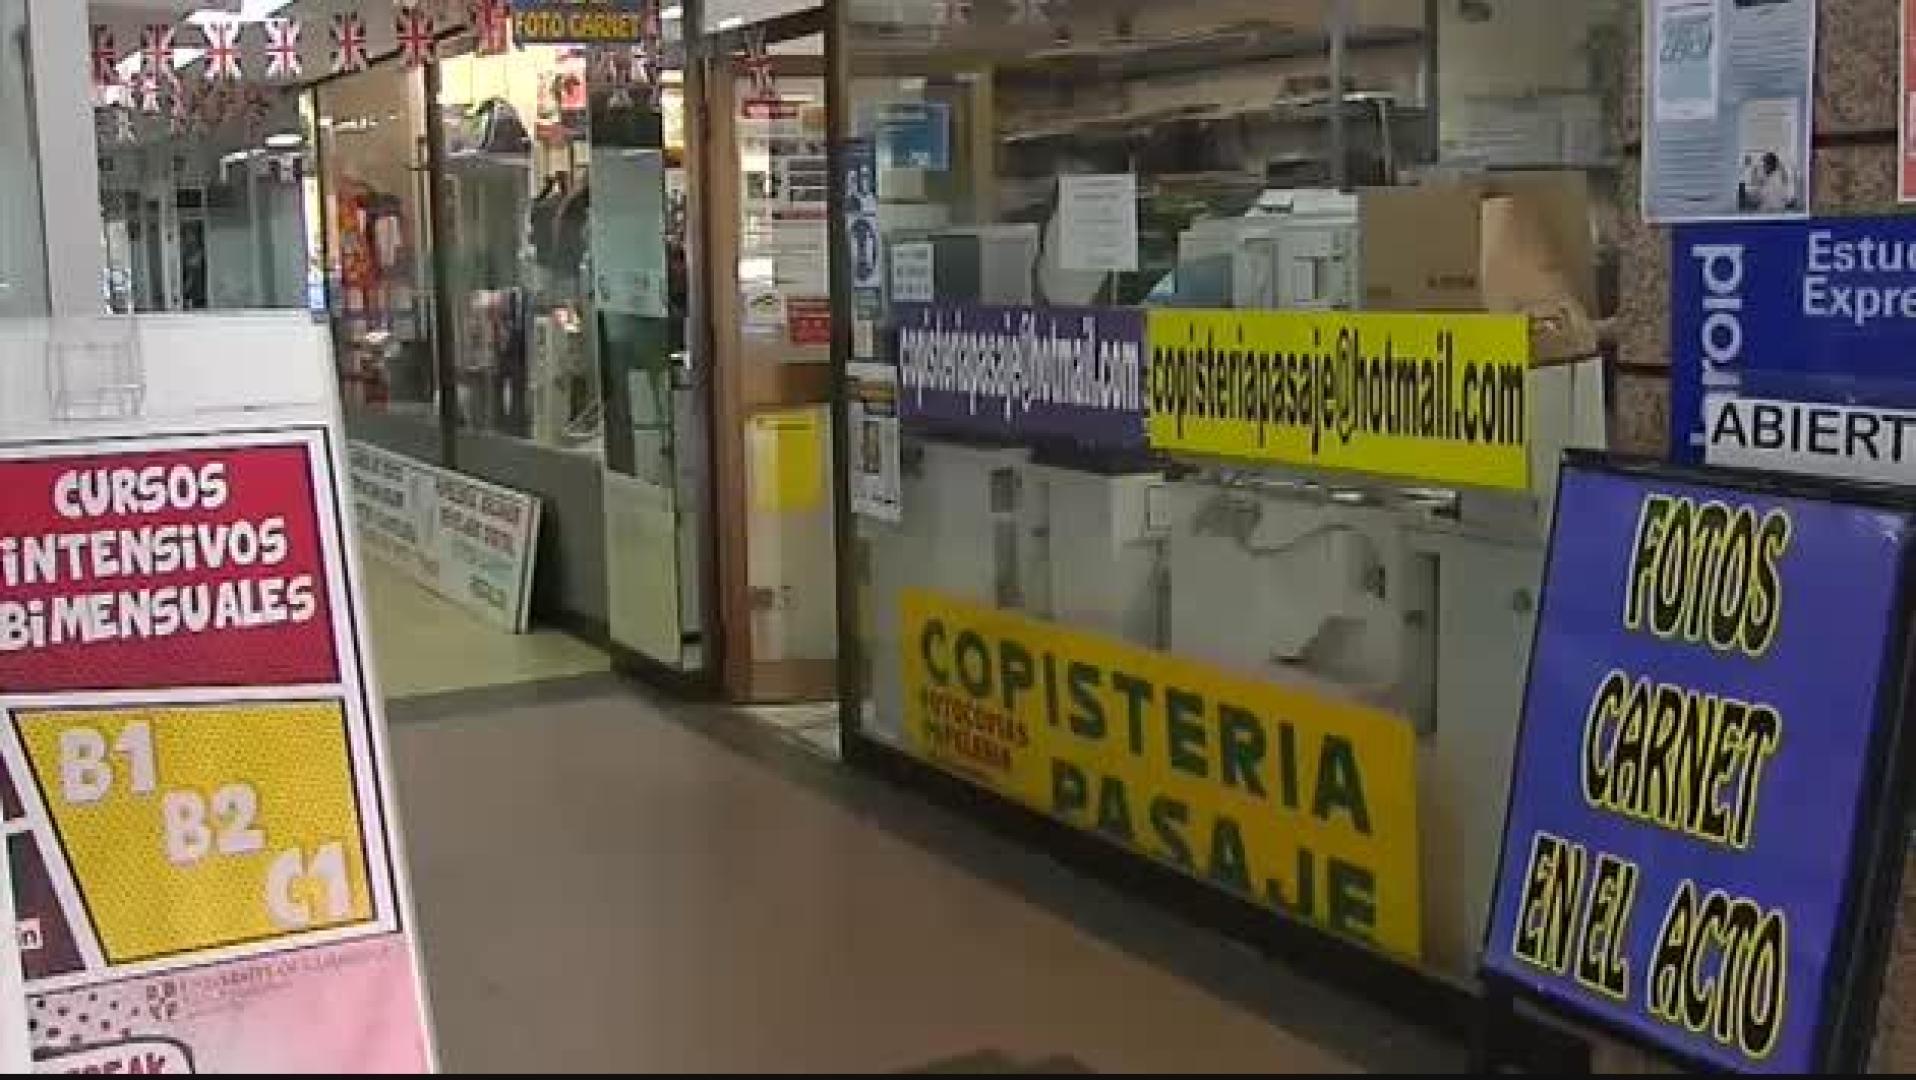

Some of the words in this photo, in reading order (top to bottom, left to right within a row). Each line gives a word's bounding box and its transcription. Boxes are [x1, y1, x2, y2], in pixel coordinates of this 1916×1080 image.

[516, 14, 565, 39] FOTO
[1152, 322, 1525, 454] copisteriapasaje@hotmail.com
[54, 463, 228, 519] CURSOS
[1623, 492, 1791, 658] FOTOS
[58, 719, 156, 803] B1
[921, 618, 1372, 834] COPISTERIA
[1581, 668, 1782, 849] CARNET
[160, 782, 267, 869] B2
[264, 840, 353, 929] C1
[1052, 756, 1378, 931] PASAJE
[1512, 830, 1587, 976] EN
[1575, 851, 1639, 1001] EL
[1647, 878, 1786, 1060] ACTO
